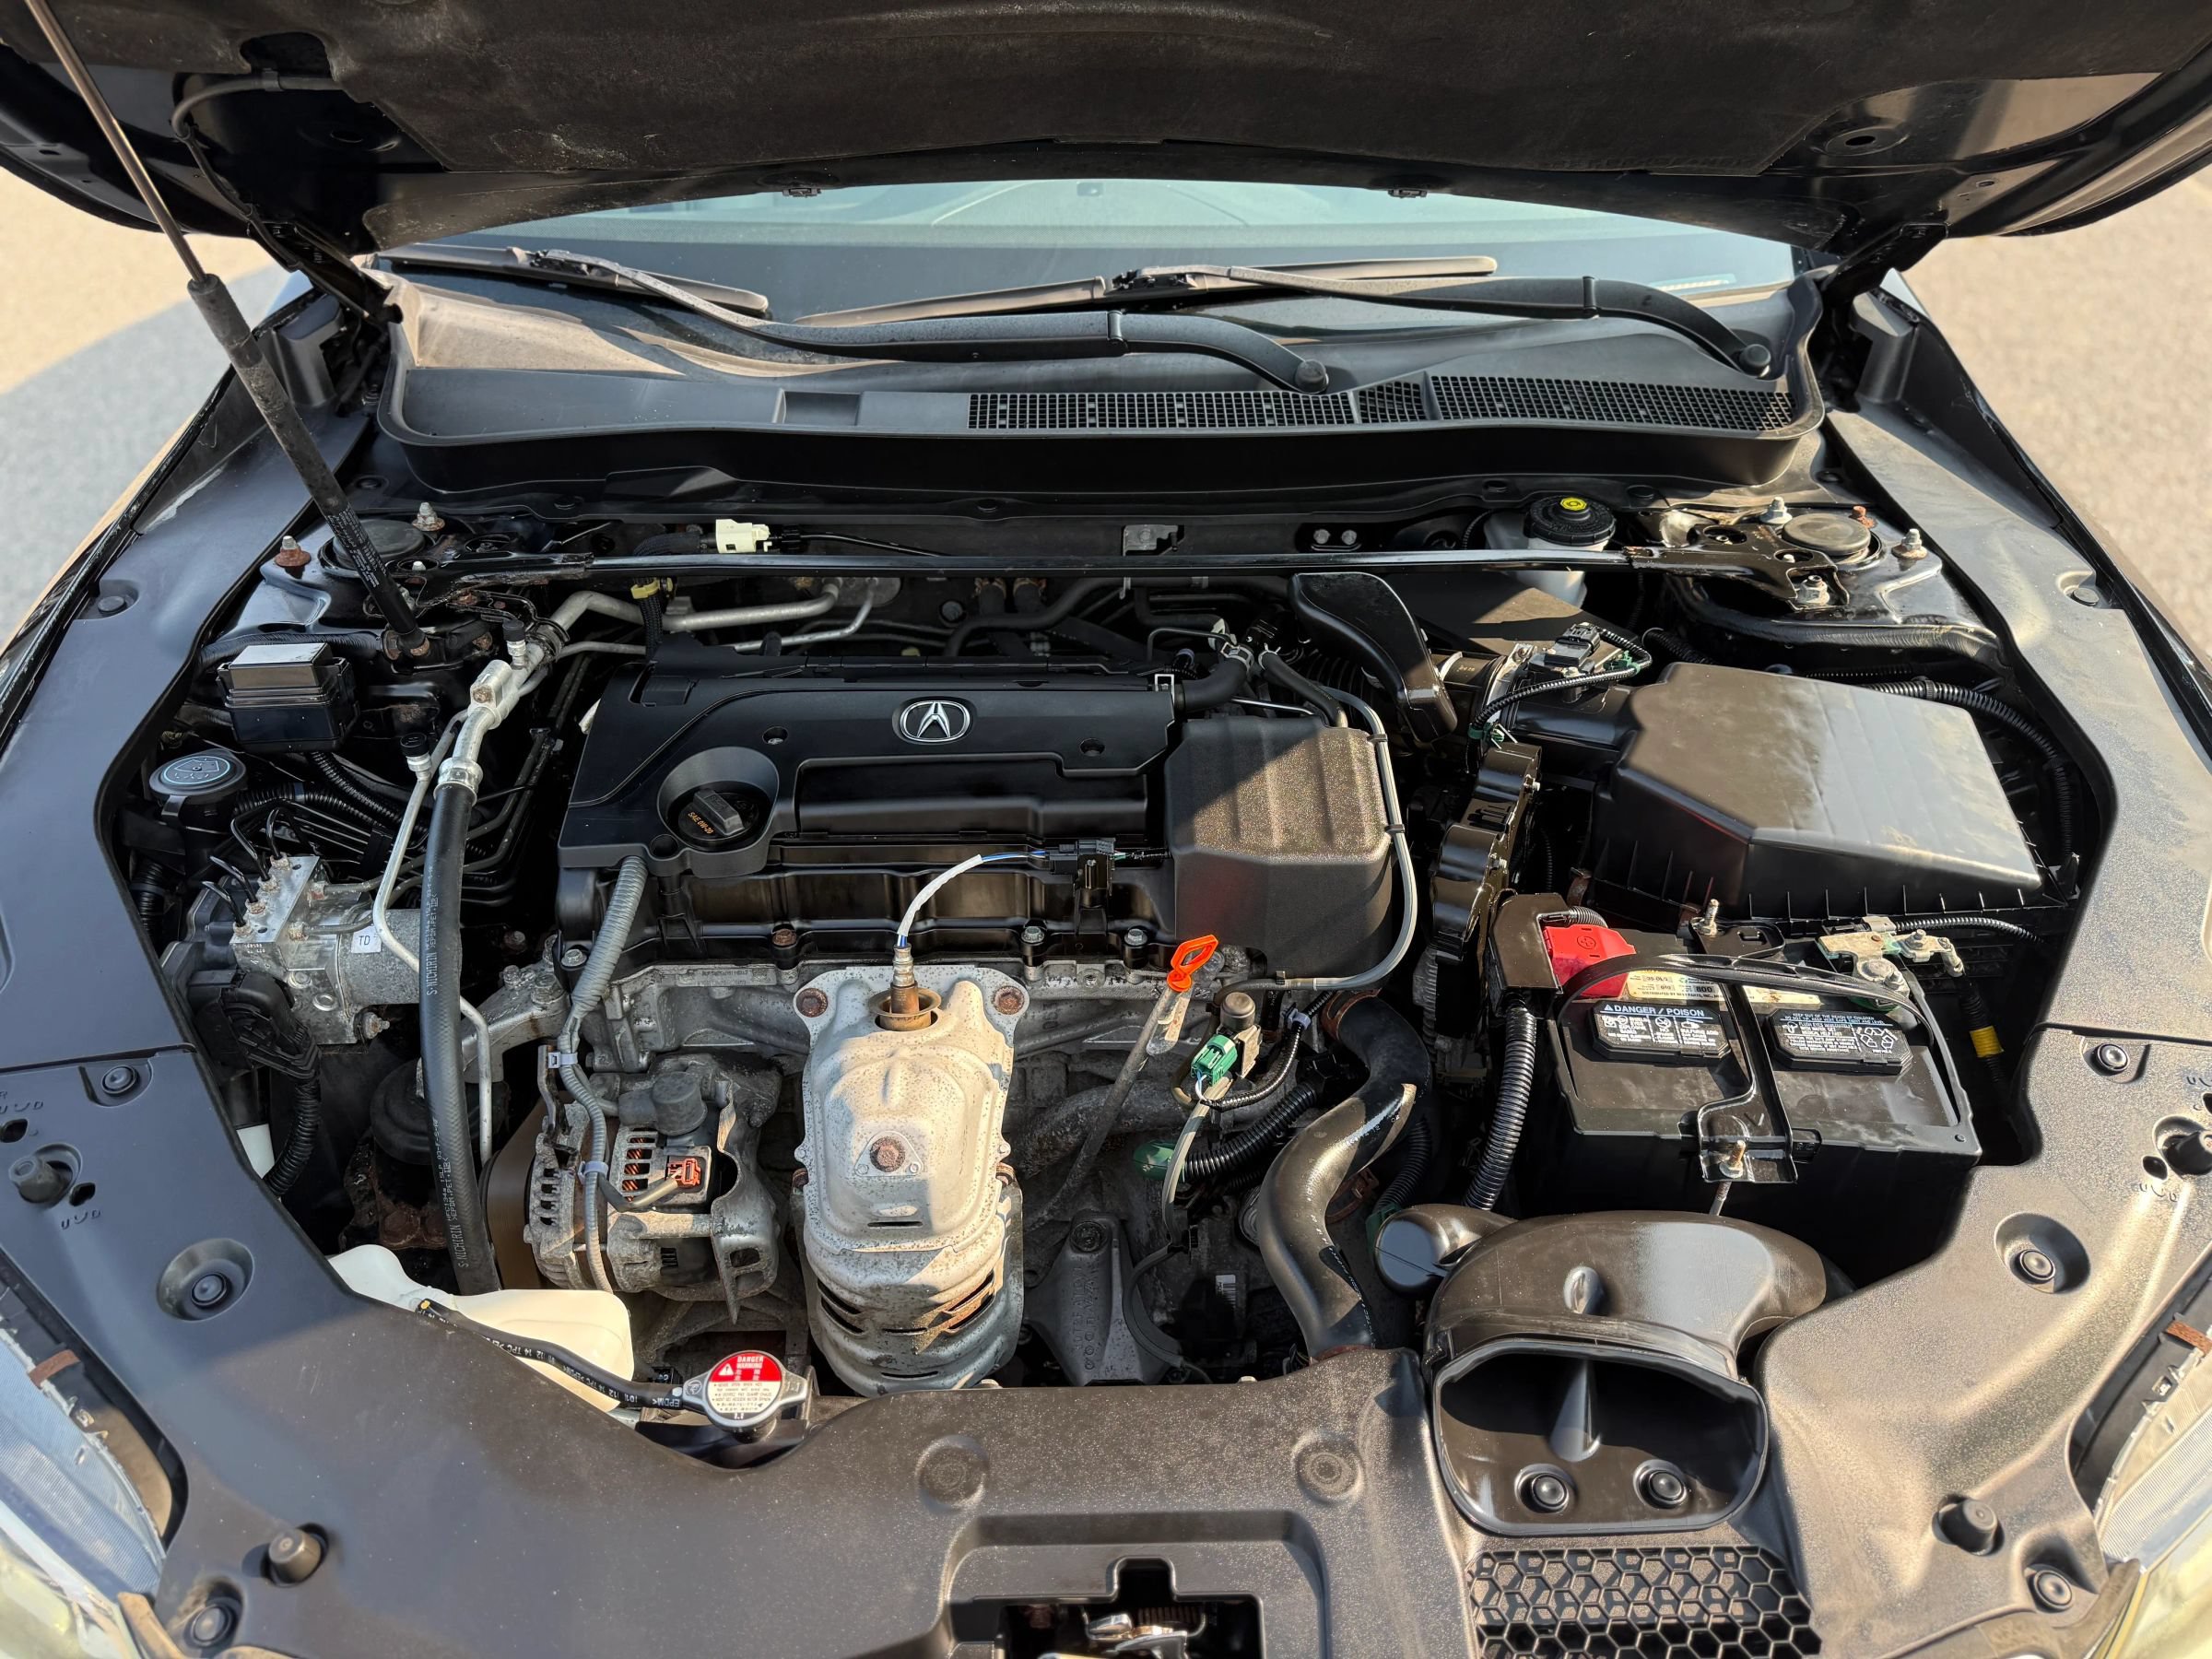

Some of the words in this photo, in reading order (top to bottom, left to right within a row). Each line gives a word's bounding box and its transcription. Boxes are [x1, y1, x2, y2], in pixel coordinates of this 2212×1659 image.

[688, 811, 701, 823] SAE
[697, 820, 714, 834] 0W-20
[1614, 1005, 1656, 1015] DANGER
[1665, 1007, 1705, 1017] POISON
[507, 1344, 522, 1355] TPC
